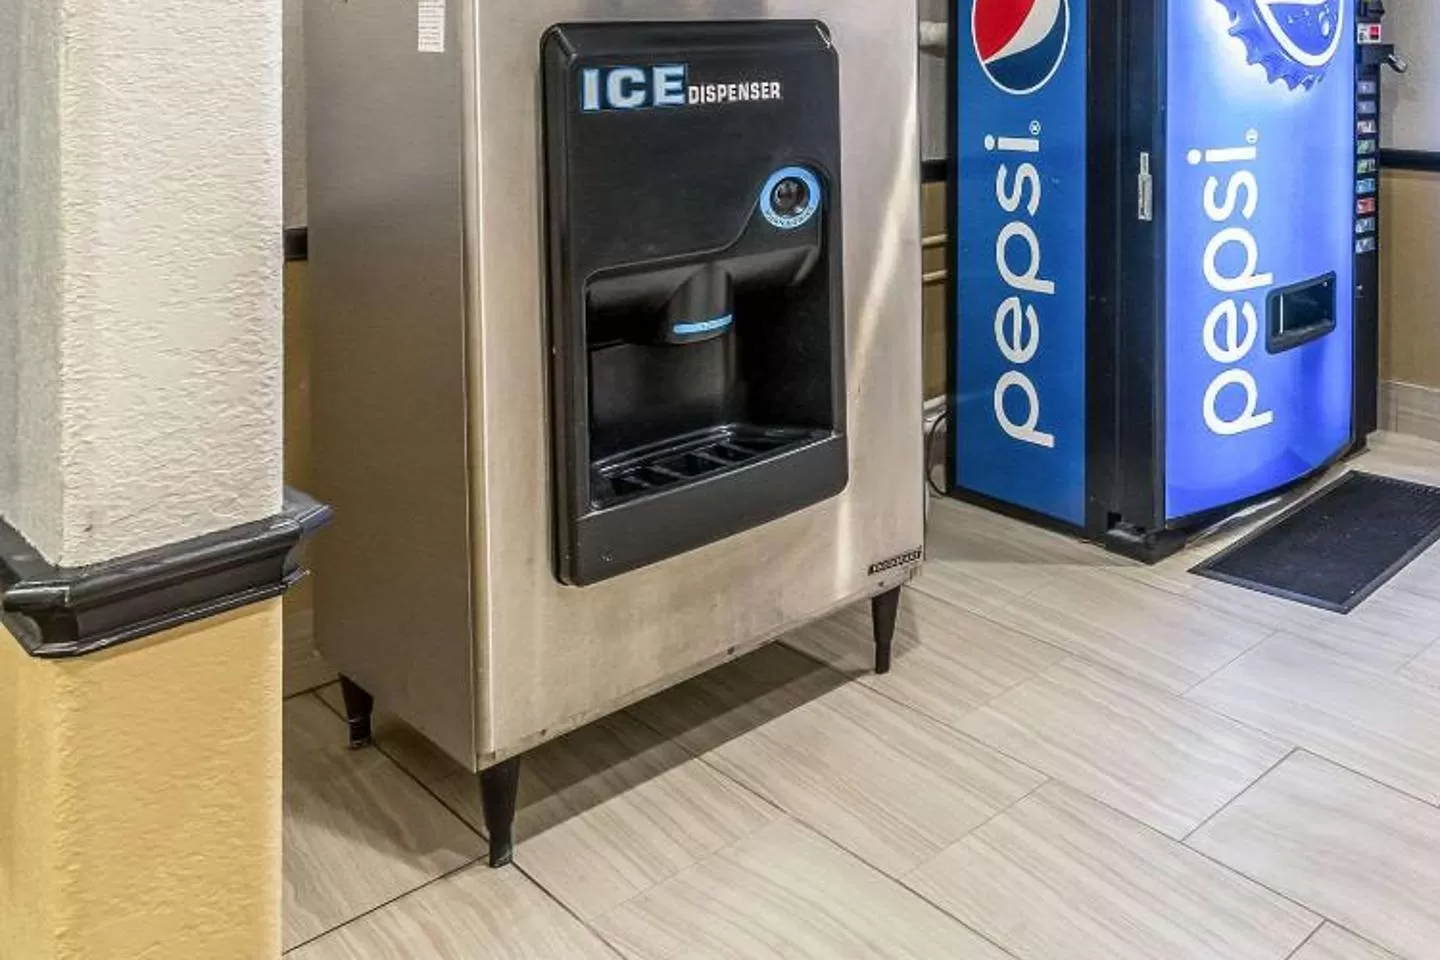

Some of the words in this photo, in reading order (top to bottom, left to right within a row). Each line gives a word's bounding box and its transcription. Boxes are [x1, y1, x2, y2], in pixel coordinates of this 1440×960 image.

[583, 64, 685, 111] ICE
[688, 81, 781, 105] DISPENSER
[985, 134, 1055, 448] pepsi
[1187, 146, 1273, 435] pepsi
